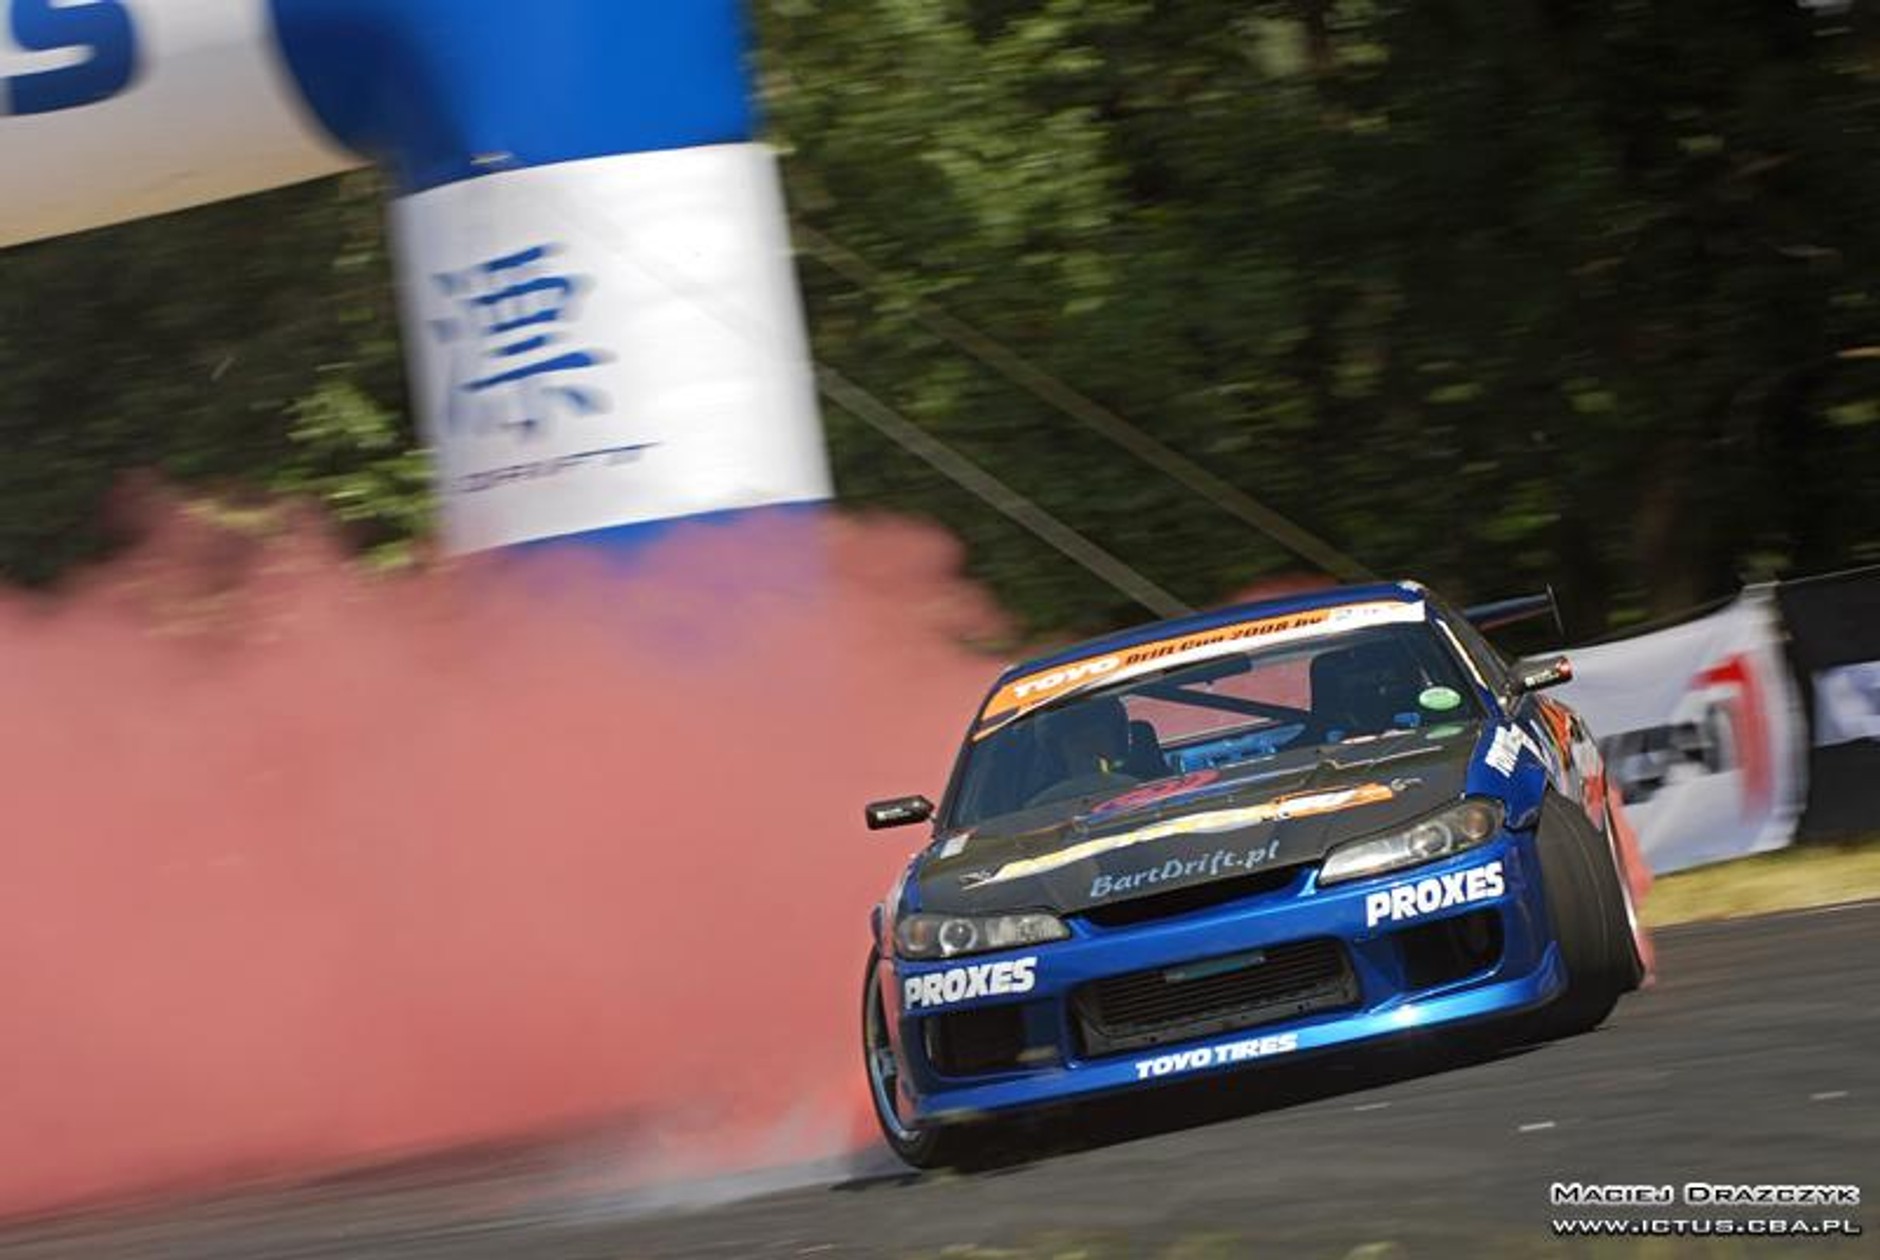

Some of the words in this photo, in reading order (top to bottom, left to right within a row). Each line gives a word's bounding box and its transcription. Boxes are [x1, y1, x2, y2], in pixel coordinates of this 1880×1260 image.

[1013, 656, 1121, 698] TOYO
[1090, 840, 1279, 898] BartDrift.pl
[1366, 861, 1505, 928] PROXES
[903, 956, 1038, 1009] PROXES
[1135, 1048, 1212, 1079] TOYO
[1214, 1034, 1298, 1063] TIRES
